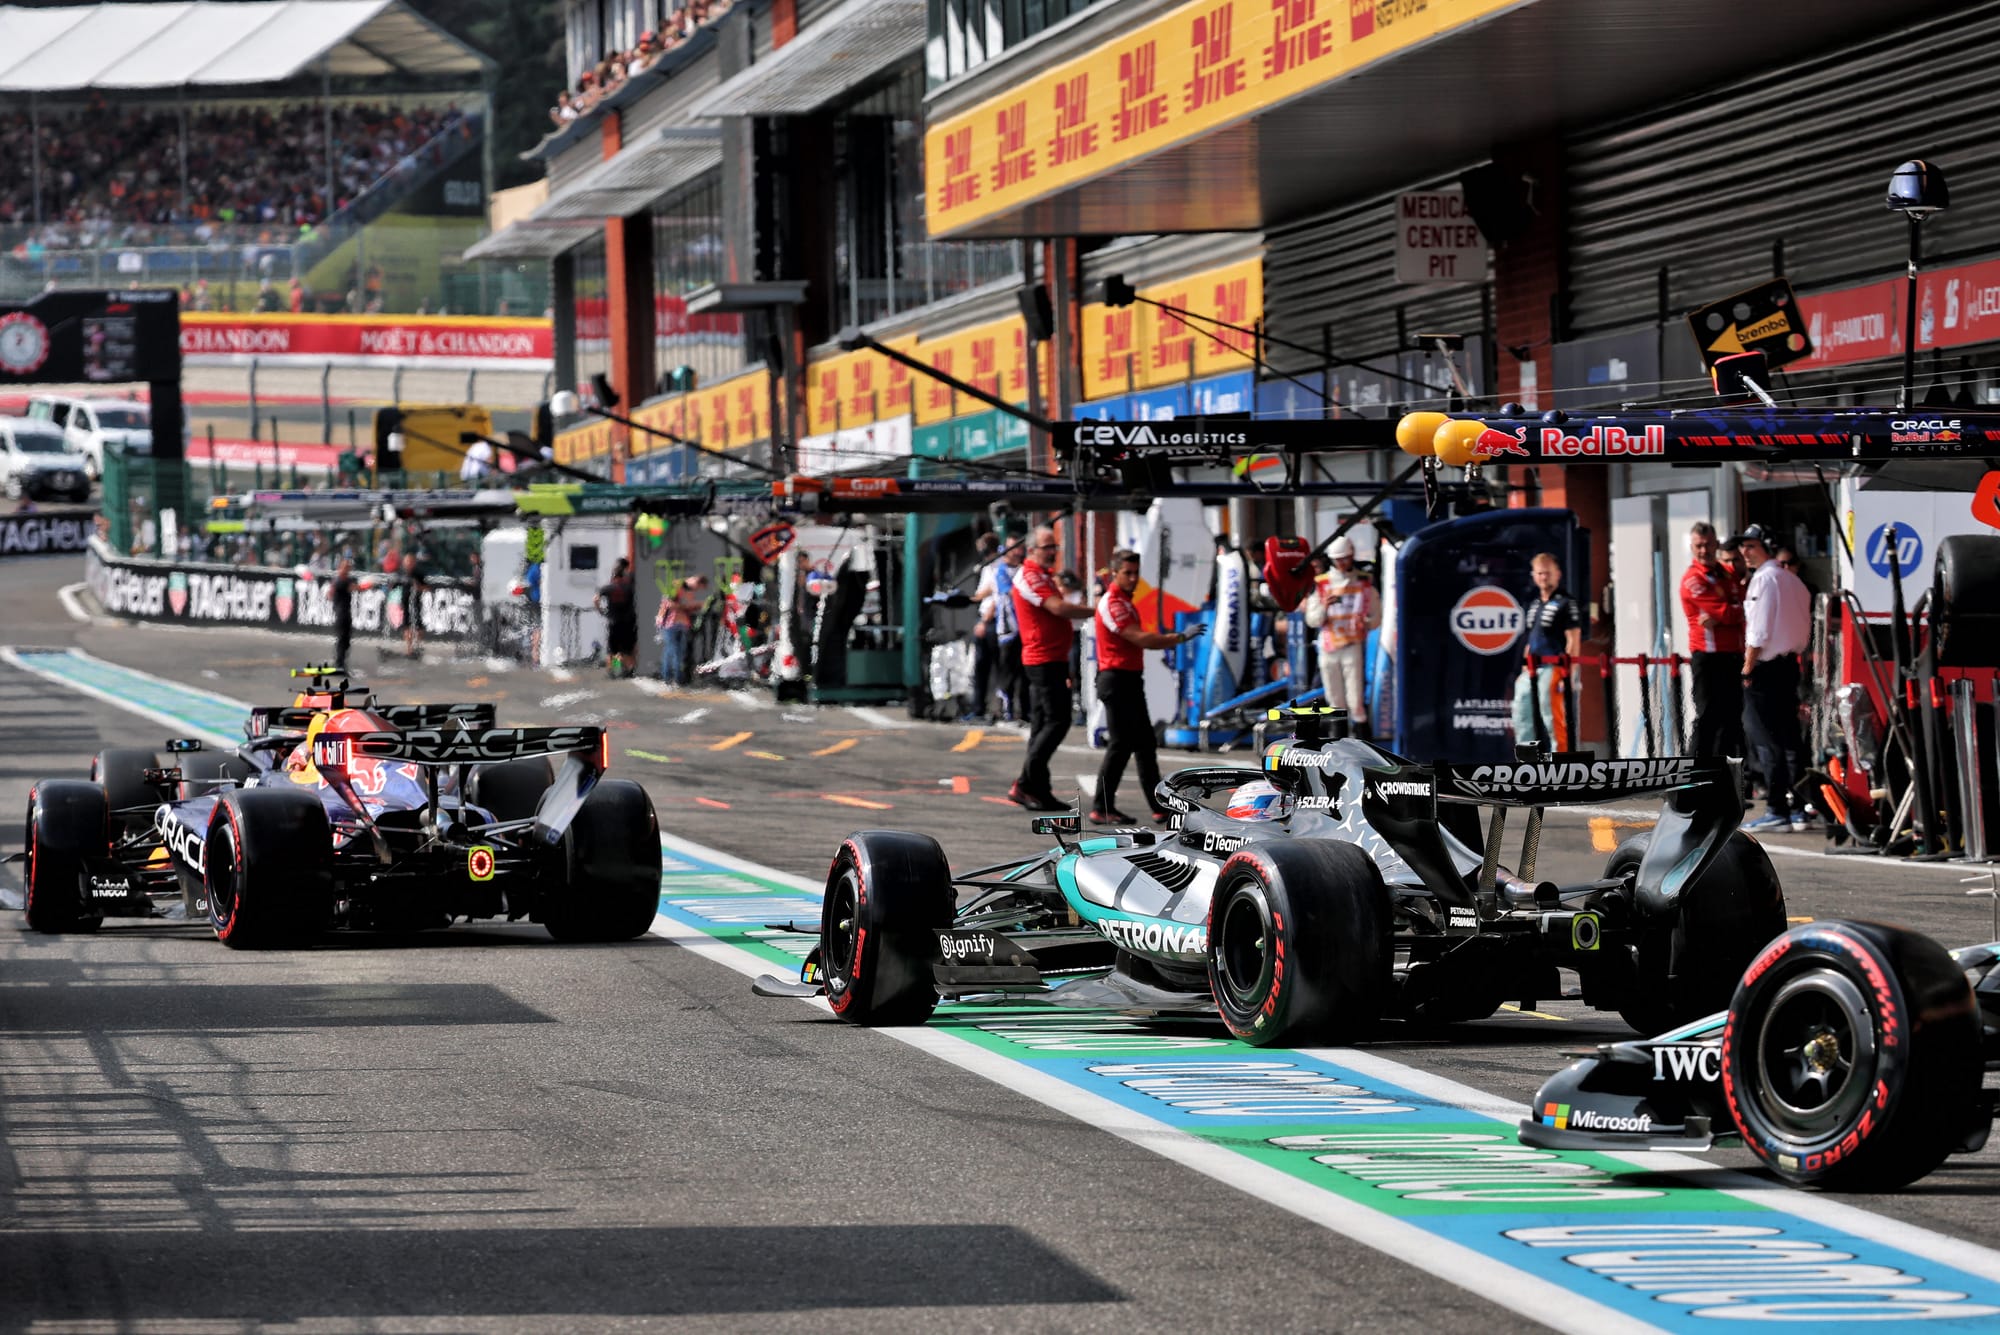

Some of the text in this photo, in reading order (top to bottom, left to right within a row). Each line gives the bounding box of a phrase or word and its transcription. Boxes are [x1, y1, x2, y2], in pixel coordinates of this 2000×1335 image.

[1403, 196, 1472, 219] MEDICA
[1406, 225, 1478, 248] CENTER
[1429, 255, 1457, 277] PIT
[1737, 318, 1787, 342] brembo
[1833, 313, 1885, 346] HAMILTON
[1891, 420, 1961, 430] ORACLE
[1161, 433, 1246, 444] LOGISTICS
[851, 479, 888, 491] Gulf
[1456, 611, 1519, 630] Gulf
[359, 728, 586, 760] ORACLE
[1281, 750, 1332, 767] Microsoft
[1470, 760, 1695, 793] CROWDSTRIKE
[1380, 782, 1431, 796] CROWDSTRIKE
[154, 803, 206, 874] ORACL
[1261, 911, 1285, 1017] P ZERO
[1652, 1047, 1722, 1082] IWC
[1572, 1110, 1652, 1132] Microsoft
[1805, 1079, 1889, 1170] P ZERO
